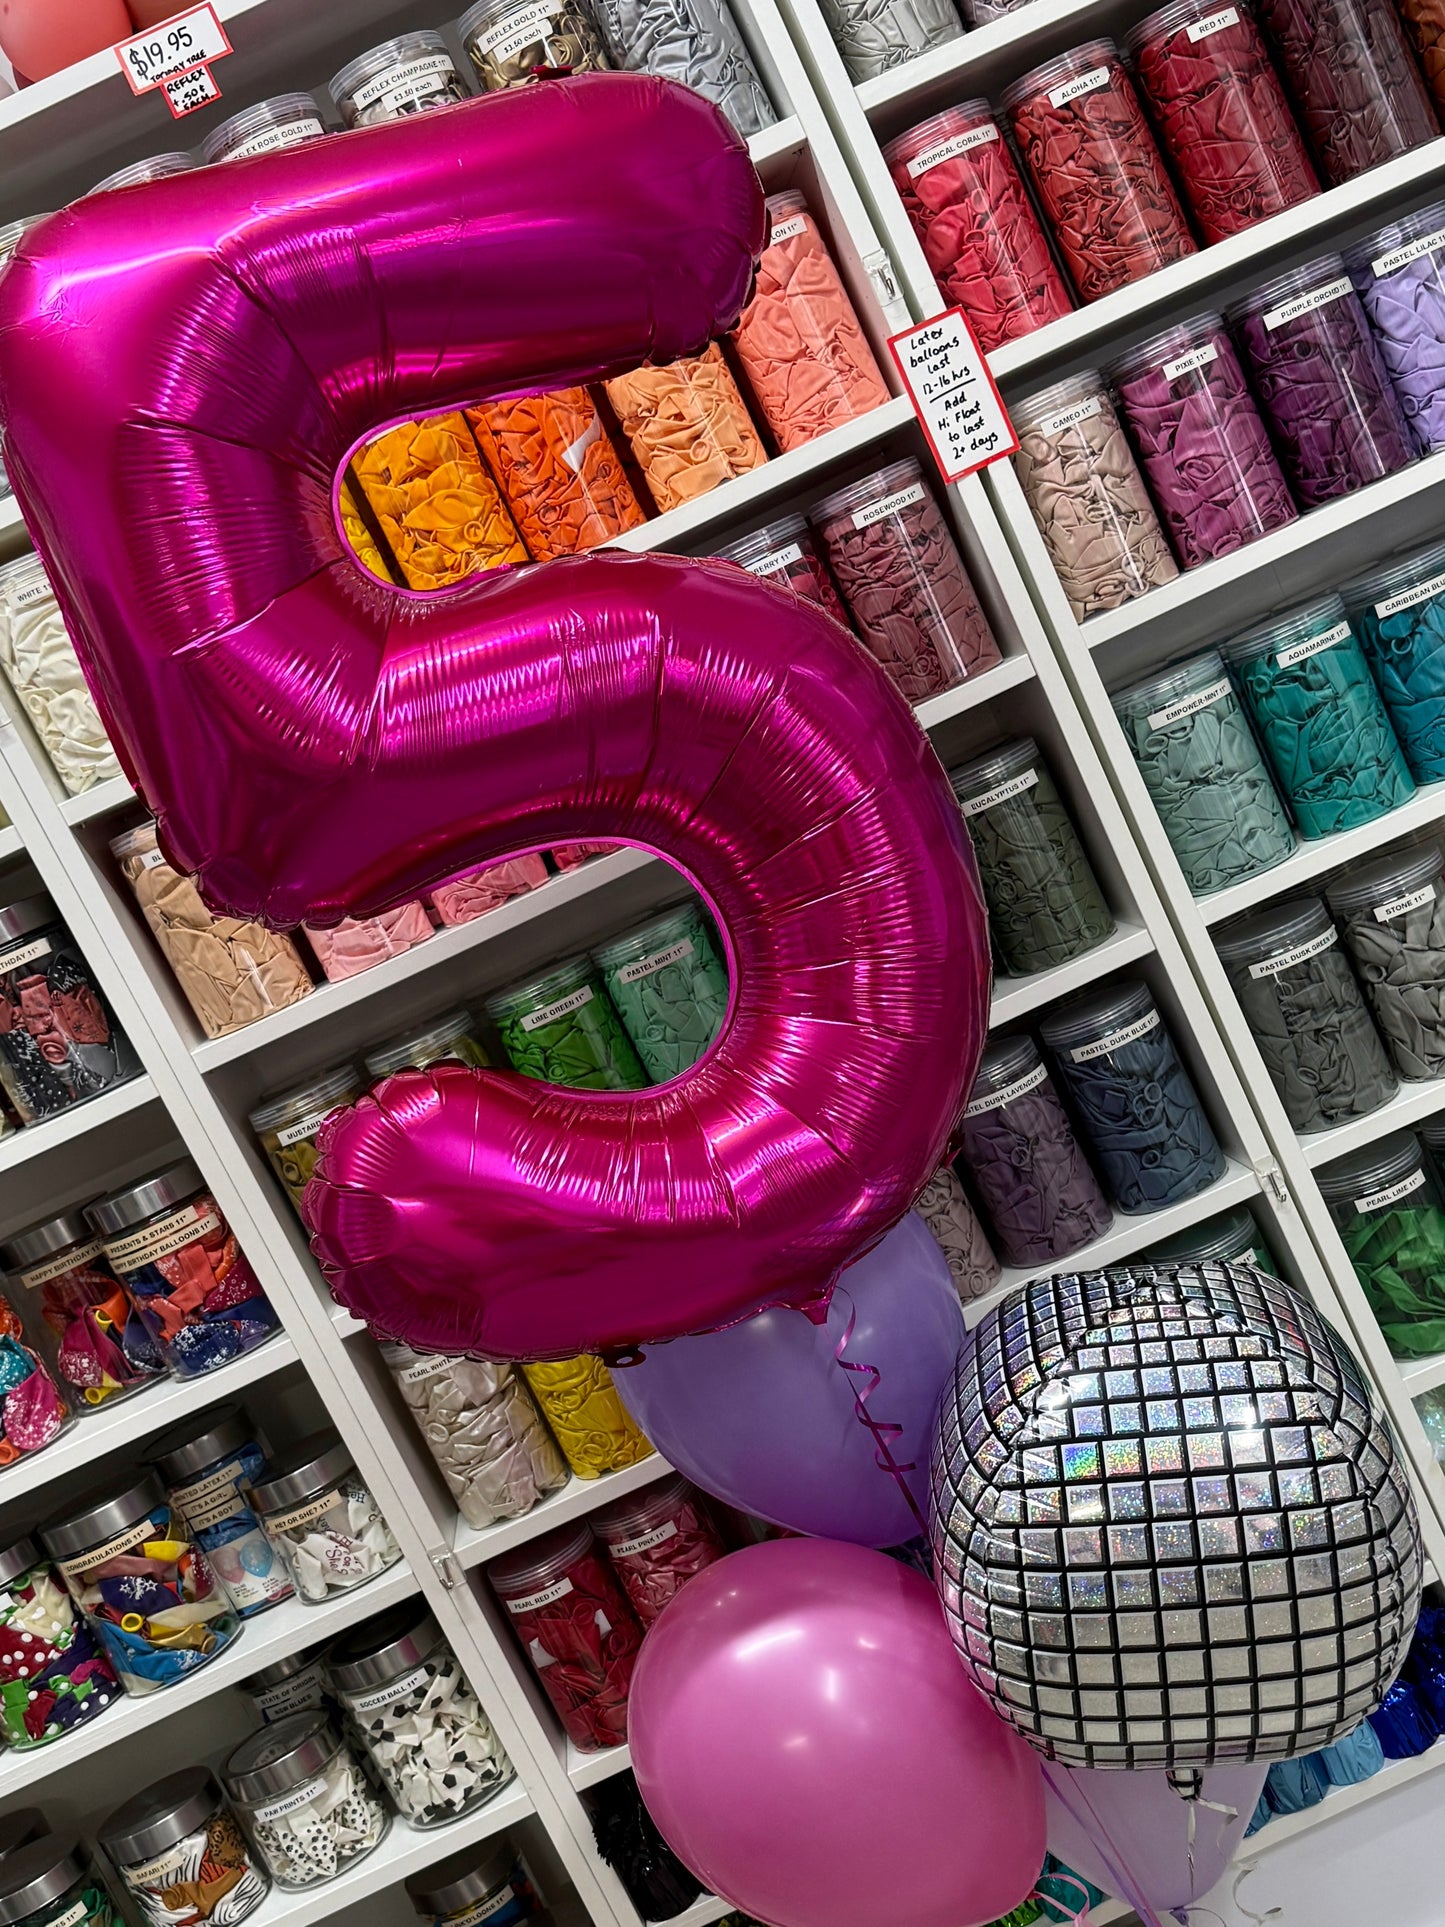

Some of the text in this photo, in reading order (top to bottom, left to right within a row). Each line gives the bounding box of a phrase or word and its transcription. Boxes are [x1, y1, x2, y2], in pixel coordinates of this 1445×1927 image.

[486, 23, 513, 45] REFLEX
[514, 10, 537, 26] GOLD
[524, 28, 542, 41] each
[1199, 21, 1216, 33] RED
[129, 26, 193, 80] $19.95
[186, 49, 207, 64] TREE
[166, 68, 206, 94] REFLEX
[362, 79, 391, 100] REFLEX
[391, 62, 438, 83] CHAMPAGNE
[415, 82, 432, 93] each
[1061, 81, 1089, 100] ALOHA
[258, 133, 280, 149] ROSE
[282, 126, 303, 140] GOLD
[917, 146, 956, 169] TROPICAL
[957, 136, 982, 149] CORAL
[1383, 250, 1415, 268] PASTEL
[1415, 240, 1438, 253] LILAC
[1281, 300, 1312, 318] PURPLE
[1314, 288, 1340, 303] ORCHID
[911, 328, 943, 350] Latex
[910, 336, 960, 368] balloons
[927, 355, 951, 374] last
[1175, 358, 1195, 372] PIXIE
[923, 366, 970, 395] 12-16 hrs
[944, 391, 967, 411] Add
[955, 400, 981, 422] Float
[948, 416, 985, 442] to last
[1053, 411, 1080, 429] CAMEO
[953, 431, 998, 460] 2+ days
[863, 497, 906, 521] ROSEWOOD
[17, 588, 42, 602] WHITE
[1385, 588, 1431, 611] CARIBBEAN
[1288, 635, 1336, 661] AQUAMARINE
[1165, 689, 1219, 721] EMPOWER-MINT
[970, 784, 1019, 810] EUCALYPTUS
[1385, 900, 1412, 915] STONE
[0, 952, 26, 970] THDAY
[626, 962, 653, 978] PASTEL
[654, 953, 672, 966] MINT
[1260, 959, 1289, 973] PASTEL
[1290, 948, 1311, 961] DUSK
[1311, 937, 1330, 951] GREEN
[531, 1013, 548, 1025] LIME
[549, 1000, 575, 1016] GREEN
[1080, 1043, 1109, 1057] PASTEL
[1111, 1033, 1131, 1046] DUSK
[1131, 1024, 1148, 1038] BLUE
[985, 1095, 1006, 1108] DUSK
[1007, 1076, 1038, 1098] LAVENDER
[287, 1120, 322, 1140] MUSTARD
[1366, 1194, 1392, 1207] PEARL
[1393, 1185, 1408, 1197] LIME
[110, 1239, 141, 1254] PRESENTS
[149, 1223, 175, 1238] STARS
[128, 1248, 159, 1267] BIRTHDAY
[160, 1228, 200, 1252] BALLOONS
[30, 1267, 53, 1282] HAPPY
[54, 1251, 92, 1273] BIRTHDAY
[408, 1367, 430, 1380] PEARL
[199, 1477, 222, 1492] LATEX
[210, 1492, 228, 1503] GIRL
[217, 1505, 233, 1517] BOY
[287, 1514, 298, 1524] OR
[299, 1506, 318, 1520] SHE?
[319, 1499, 331, 1510] 11"
[66, 1529, 144, 1572] CONGRATULATIONS 11"
[617, 1542, 637, 1553] PEARL
[638, 1537, 655, 1547] PINK
[514, 1598, 534, 1609] PEARL
[534, 1592, 550, 1604] RED
[261, 1675, 316, 1705] STATE OF ORIGIN
[289, 1693, 313, 1709] BLUES
[360, 1677, 418, 1709] SOCCER BALL 11"
[264, 1786, 317, 1818] PAW PRINTS 11"
[136, 1860, 172, 1880] SAFARI 11"
